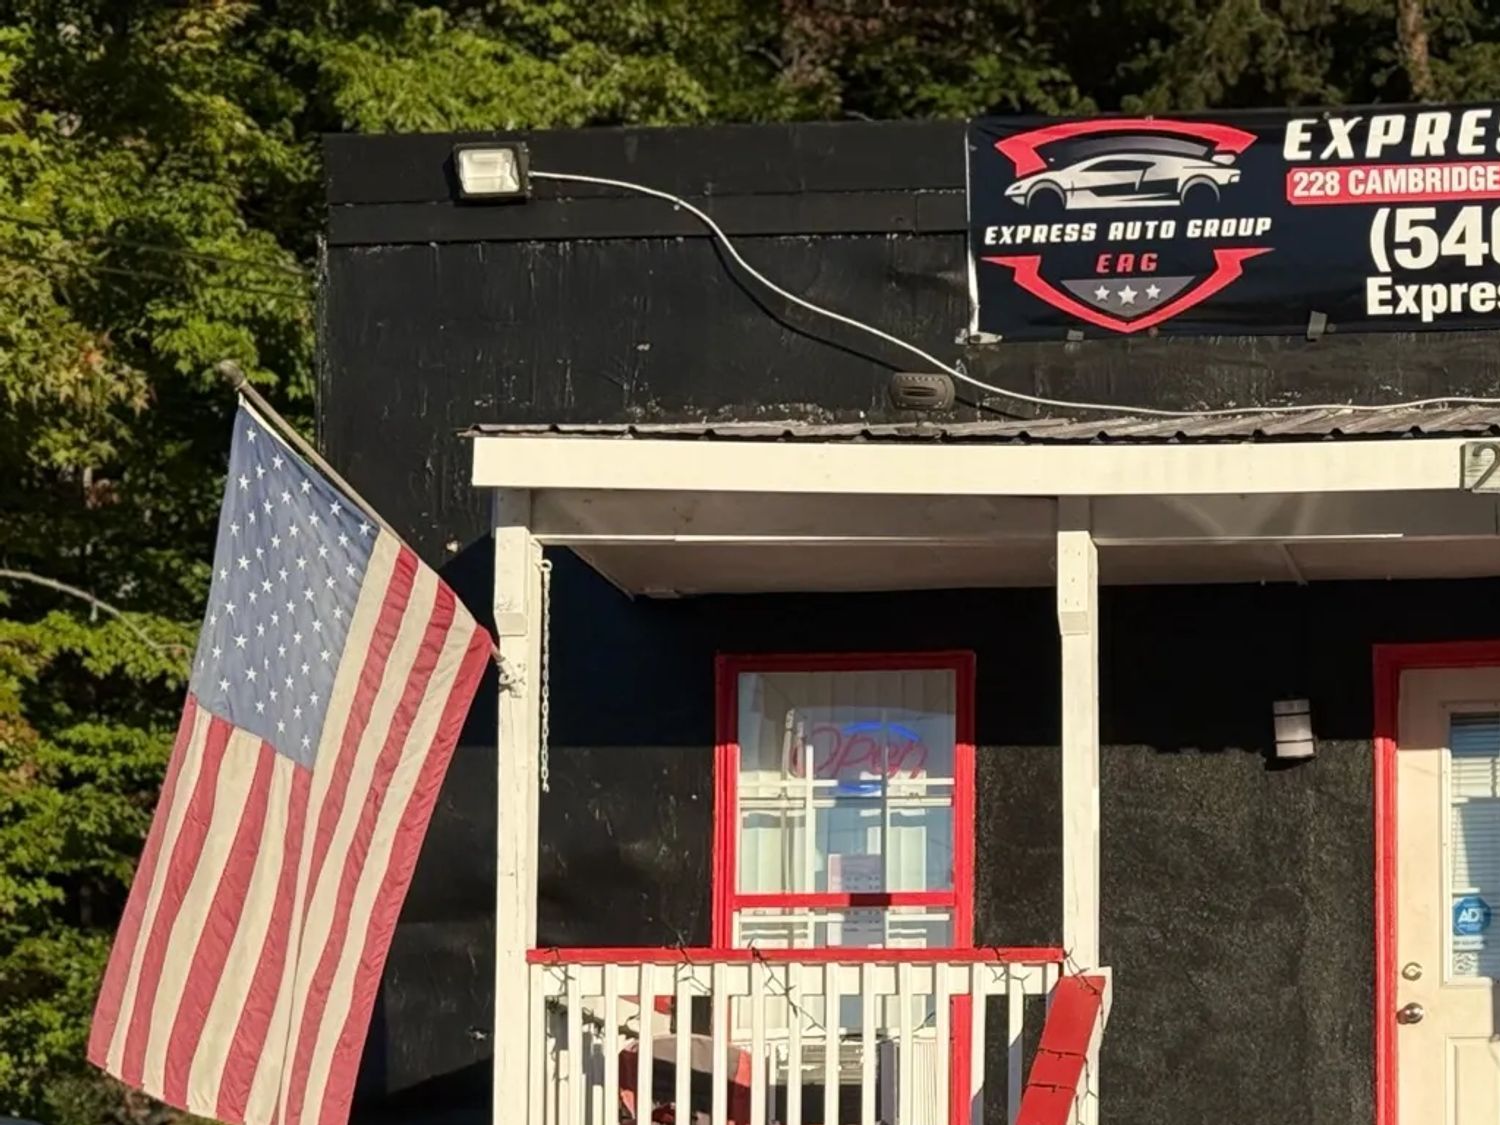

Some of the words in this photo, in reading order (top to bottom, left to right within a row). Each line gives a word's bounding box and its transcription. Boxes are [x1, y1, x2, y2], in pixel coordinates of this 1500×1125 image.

[1293, 170, 1340, 197] 228
[1348, 164, 1500, 195] CAMBRIDGE
[985, 222, 1098, 246] EXPRESS
[1108, 219, 1176, 242] AUTO
[1186, 217, 1272, 239] GROUP
[1096, 253, 1159, 274] EAG
